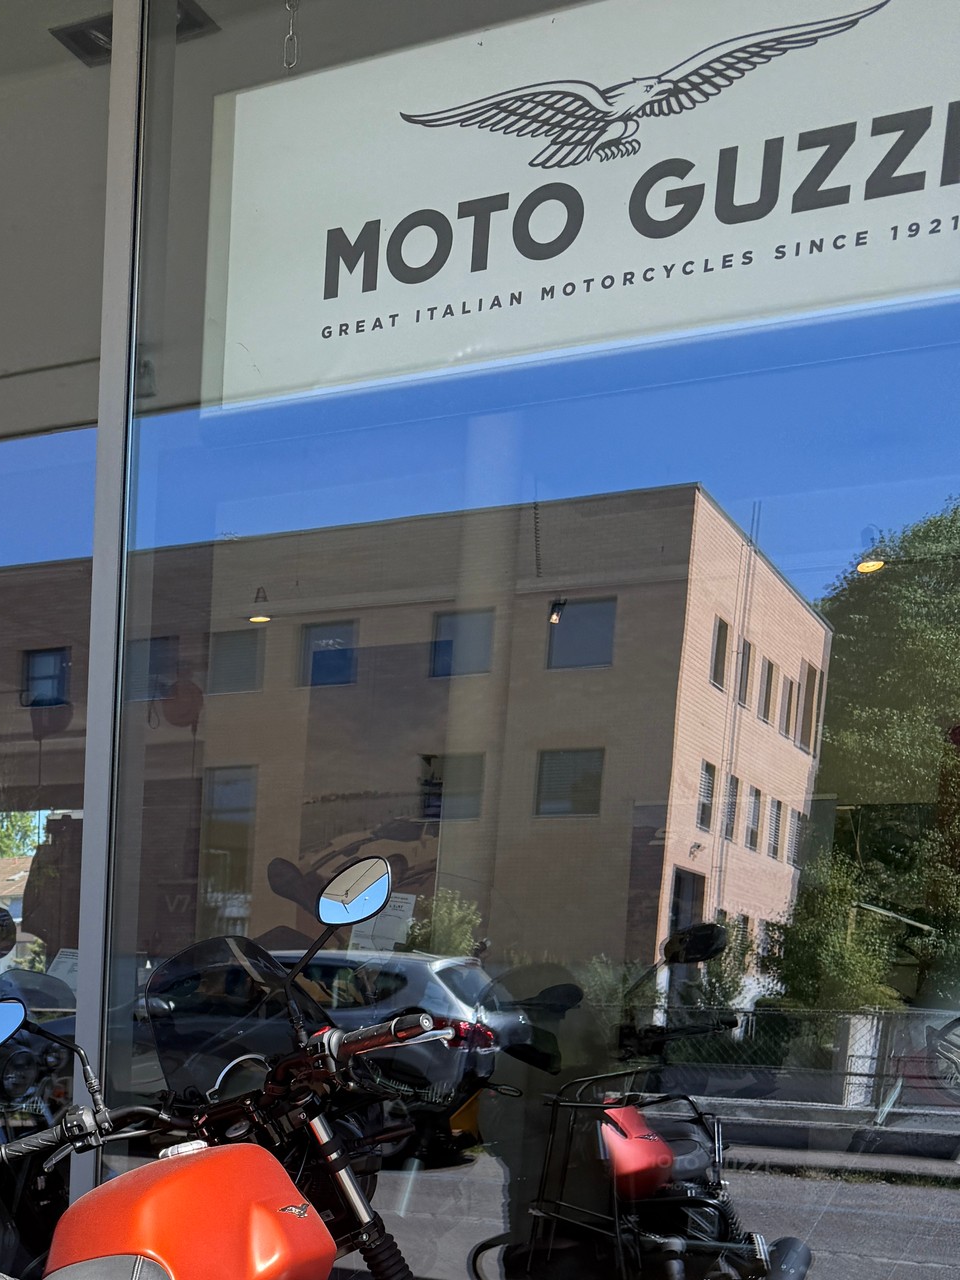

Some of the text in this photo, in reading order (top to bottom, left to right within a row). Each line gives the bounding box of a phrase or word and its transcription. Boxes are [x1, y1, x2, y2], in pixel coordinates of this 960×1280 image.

[321, 214, 960, 339] GREAT ITALIAN MOTORCYCLES SINCE 1921
[323, 100, 960, 300] MOTO GUZZI
